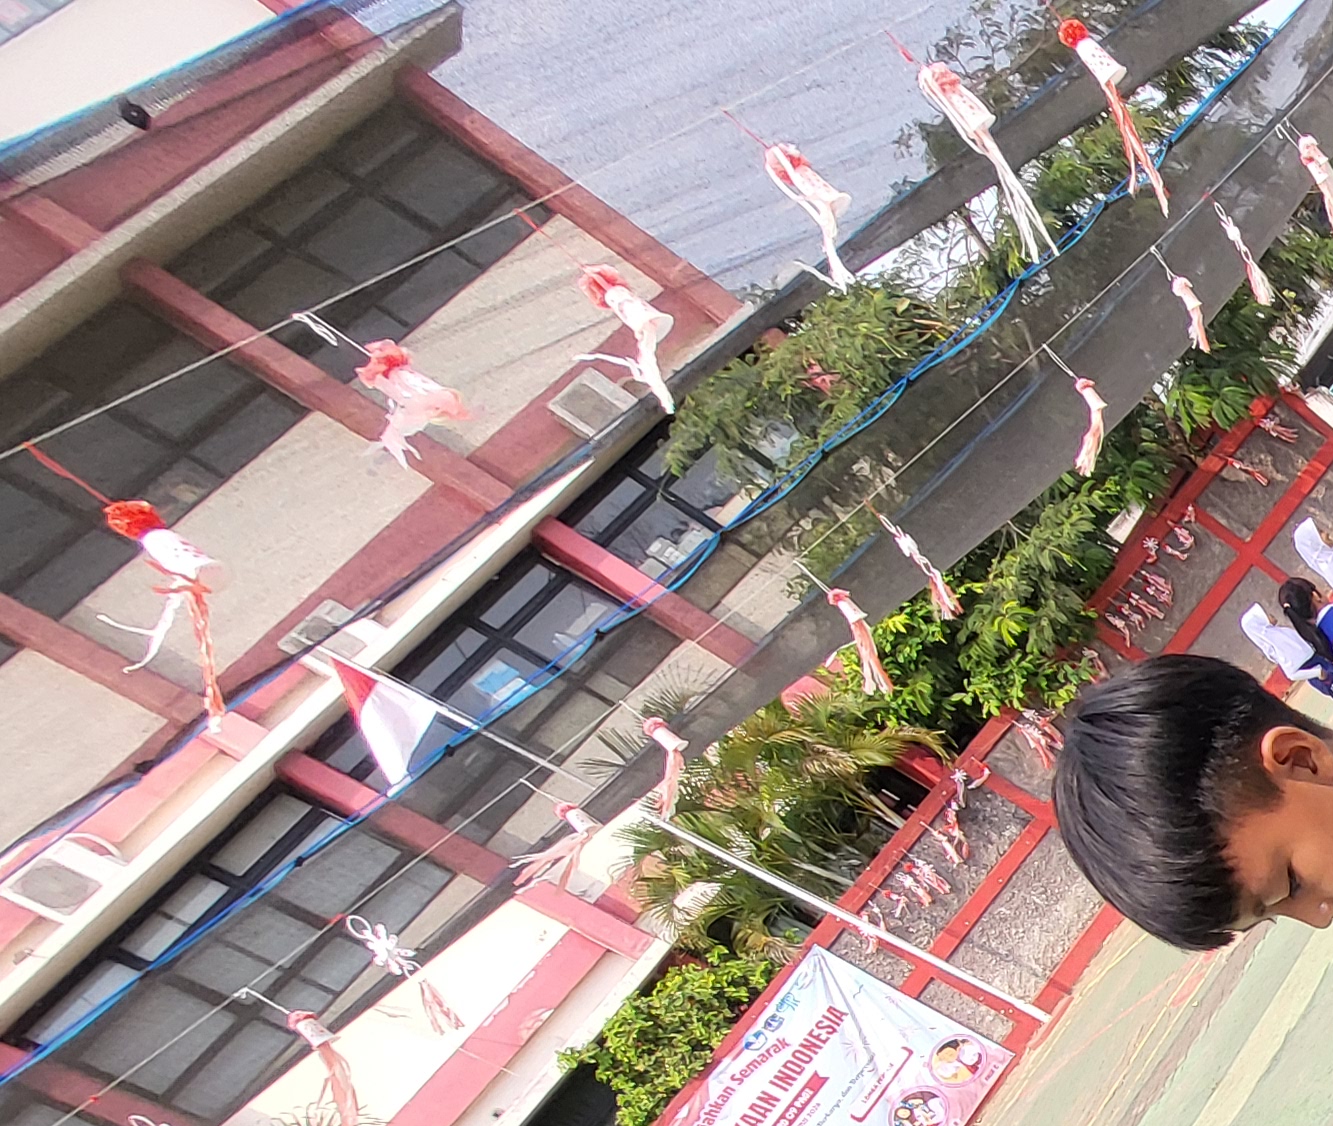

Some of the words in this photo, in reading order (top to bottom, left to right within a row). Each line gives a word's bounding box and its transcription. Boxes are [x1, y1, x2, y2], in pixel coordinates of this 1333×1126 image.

[728, 1037, 789, 1086] Semarak
[767, 1003, 850, 1093] INDONESIA
[783, 1106, 799, 1120] 09
